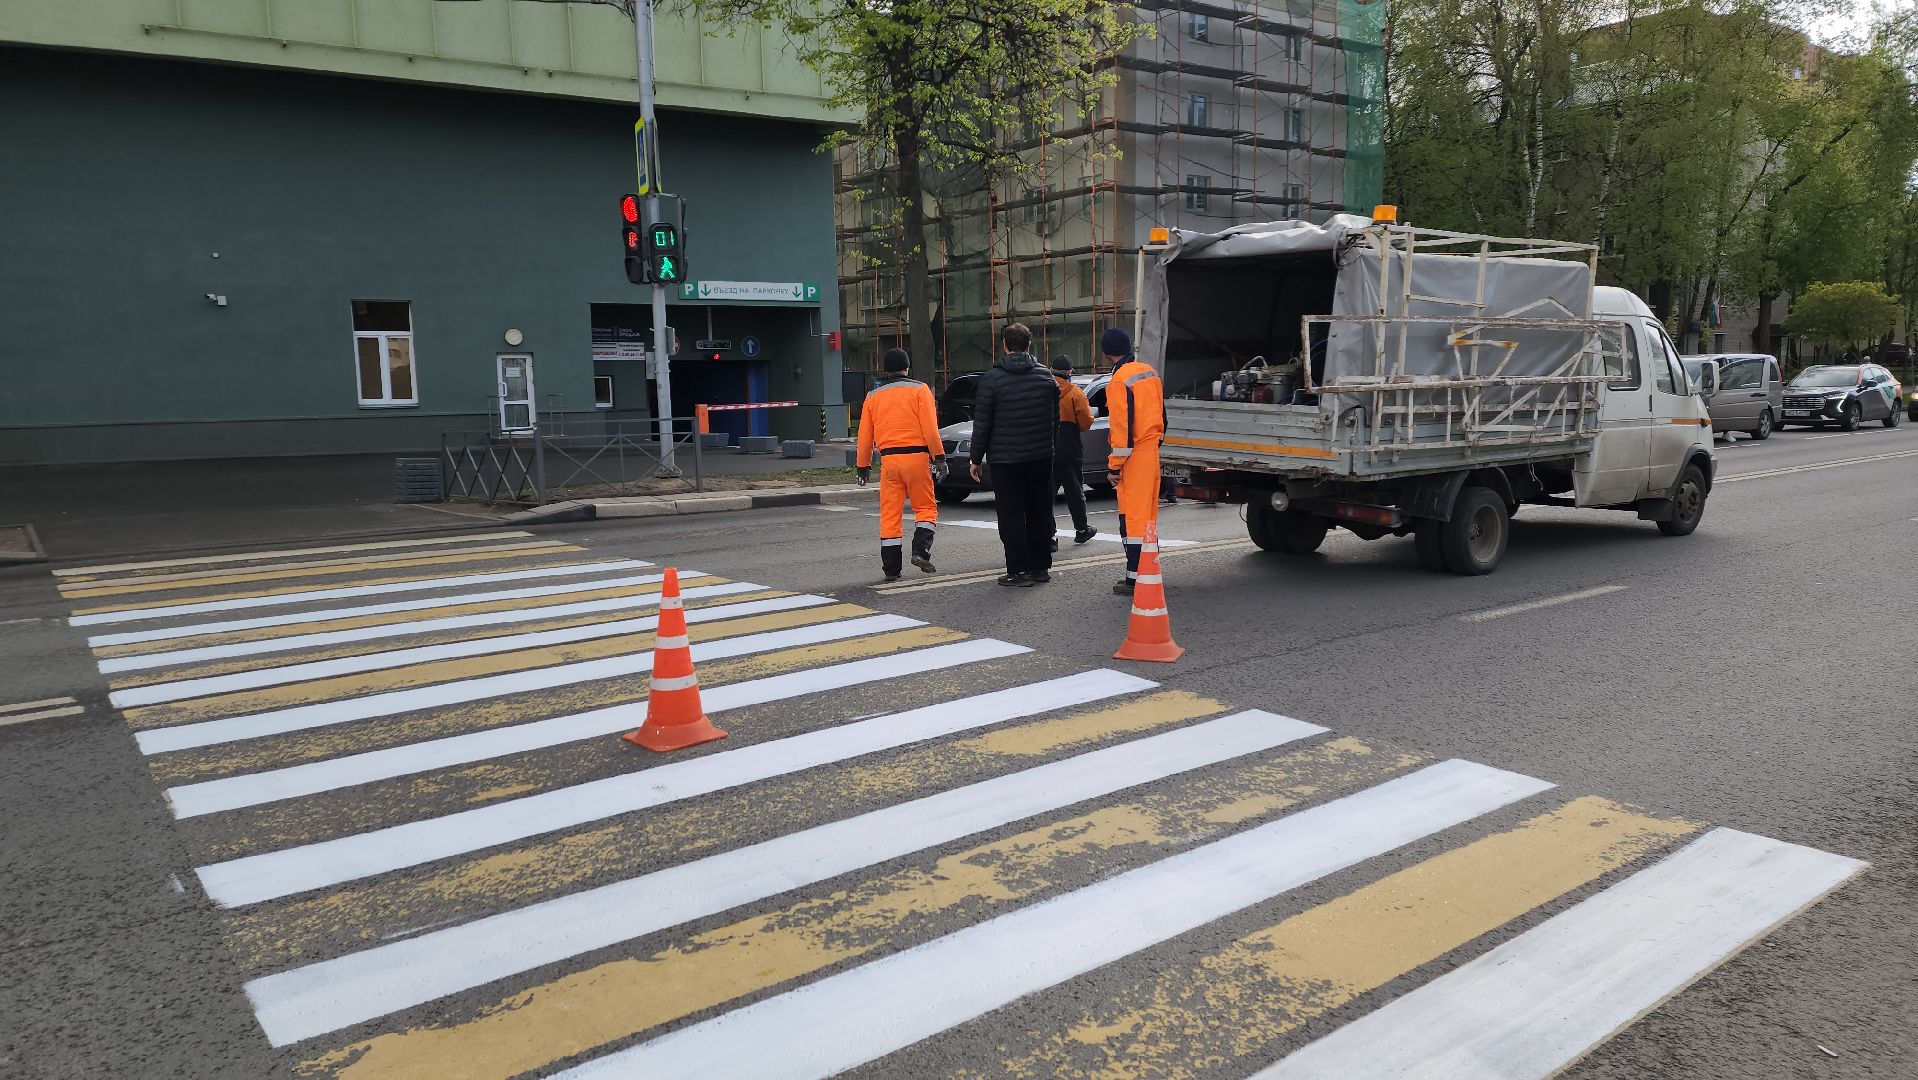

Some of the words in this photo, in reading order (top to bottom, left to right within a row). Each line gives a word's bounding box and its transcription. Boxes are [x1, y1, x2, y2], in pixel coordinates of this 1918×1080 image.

[655, 231, 675, 247] 01
[713, 286, 738, 295] ВЪЕЗД
[807, 286, 817, 298] P
